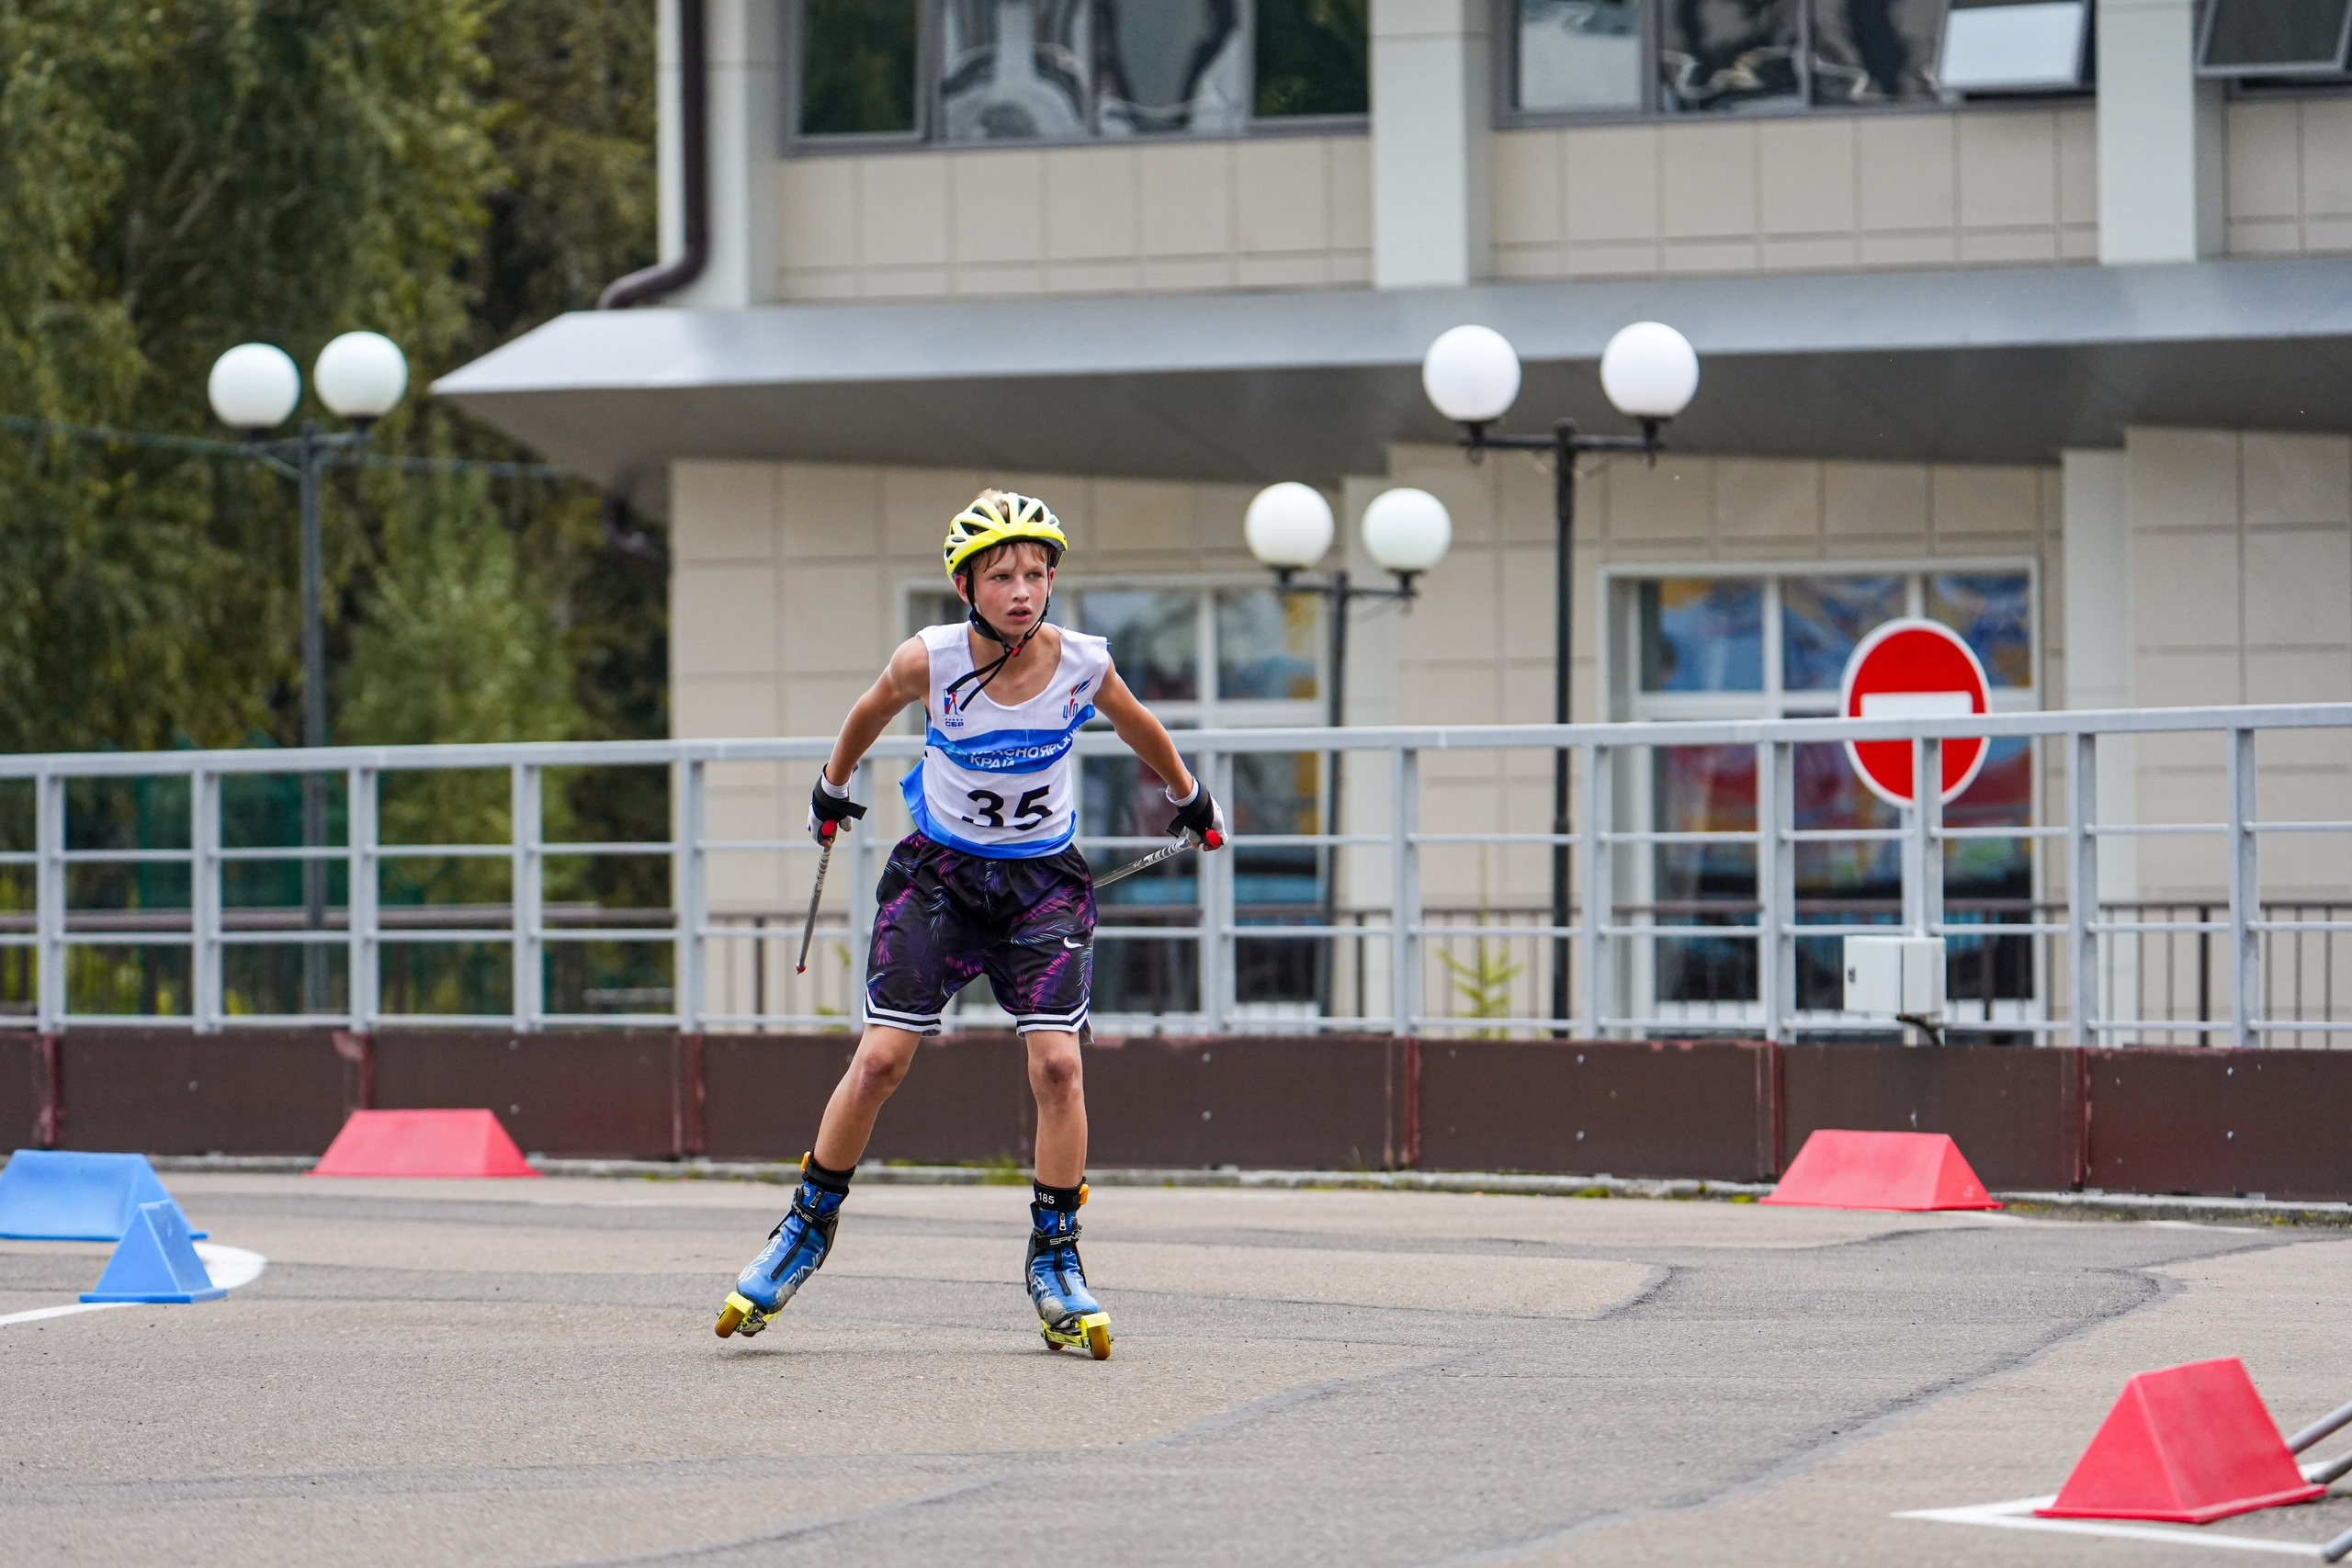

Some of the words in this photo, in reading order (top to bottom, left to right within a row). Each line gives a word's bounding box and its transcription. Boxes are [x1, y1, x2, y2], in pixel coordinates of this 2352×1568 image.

[970, 755, 1015, 769] КРАЙ
[961, 784, 1054, 831] 35
[1037, 1191, 1055, 1204] 185
